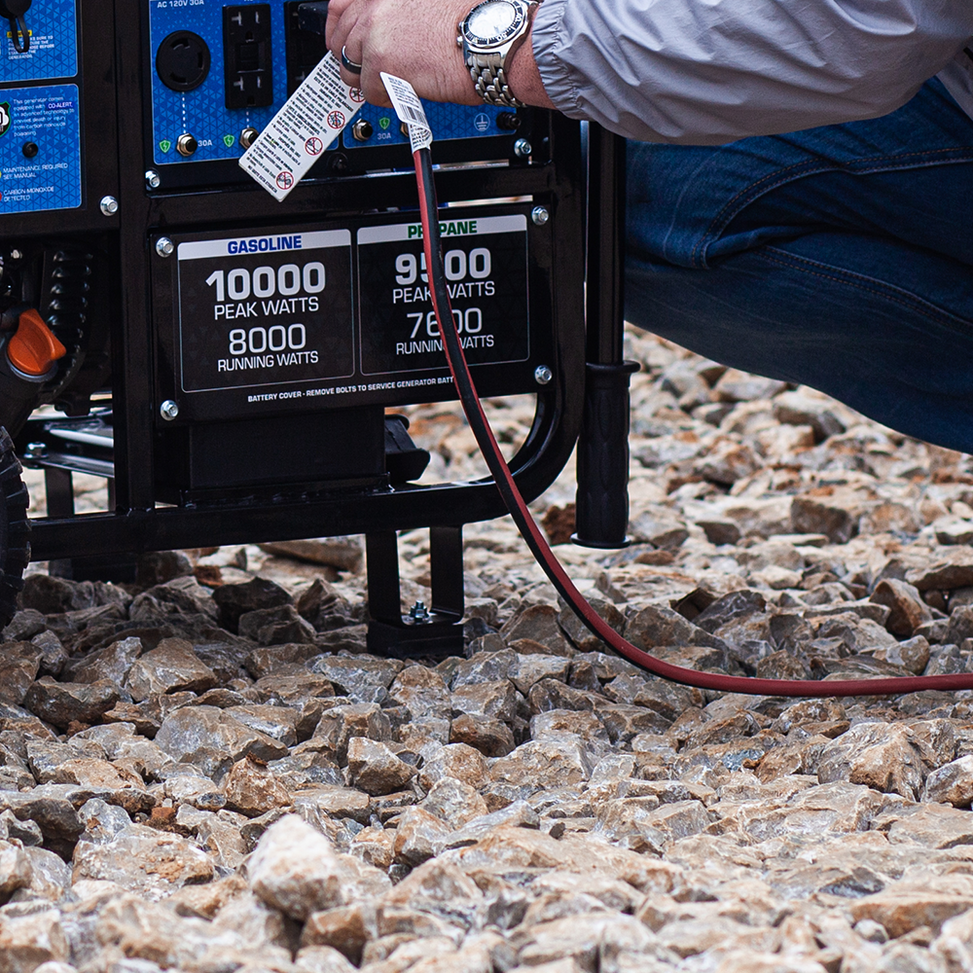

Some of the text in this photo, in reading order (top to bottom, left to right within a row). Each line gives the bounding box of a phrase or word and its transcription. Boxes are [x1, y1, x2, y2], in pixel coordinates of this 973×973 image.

[197, 139, 213, 147] 30A
[227, 235, 302, 255] GASOLINE
[205, 261, 326, 302] 10000
[214, 296, 319, 321] PEAK WATTS
[229, 323, 306, 356] 8000
[396, 339, 443, 356] RUNNIN
[217, 350, 319, 372] RUNNING WATTS
[247, 393, 278, 402] BATTERY
[278, 390, 302, 400] COVER
[306, 387, 334, 397] REMOVE
[335, 385, 357, 394] BOLTS
[367, 381, 396, 391] SERVICE
[396, 377, 437, 388] GENERATOR
[437, 376, 454, 384] BATT
